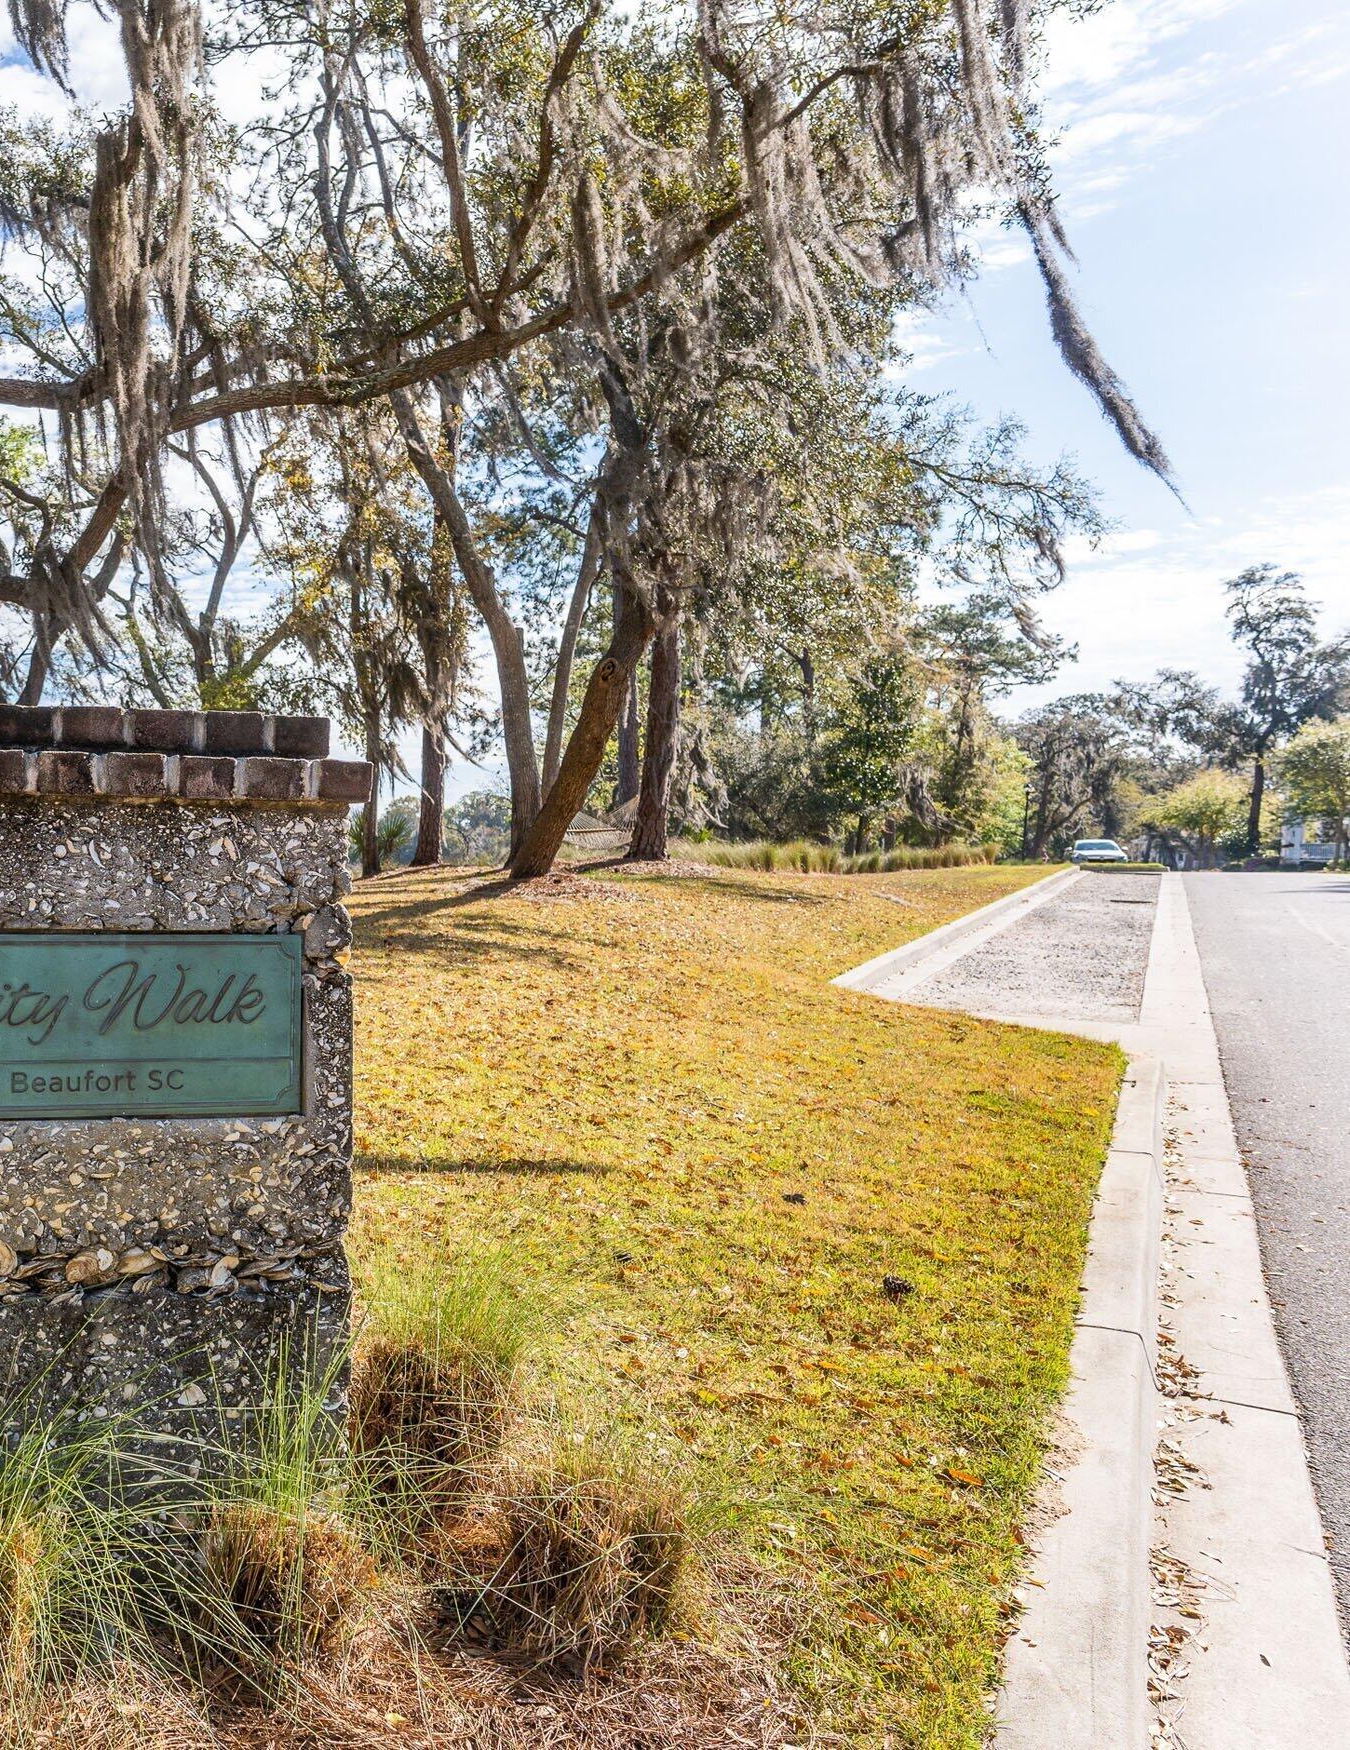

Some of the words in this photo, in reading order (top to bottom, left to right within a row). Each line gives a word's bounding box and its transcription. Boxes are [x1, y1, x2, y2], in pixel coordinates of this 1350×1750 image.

[83, 960, 267, 1035] Walk
[10, 1070, 135, 1093] Beaufort
[147, 1069, 184, 1090] SC
